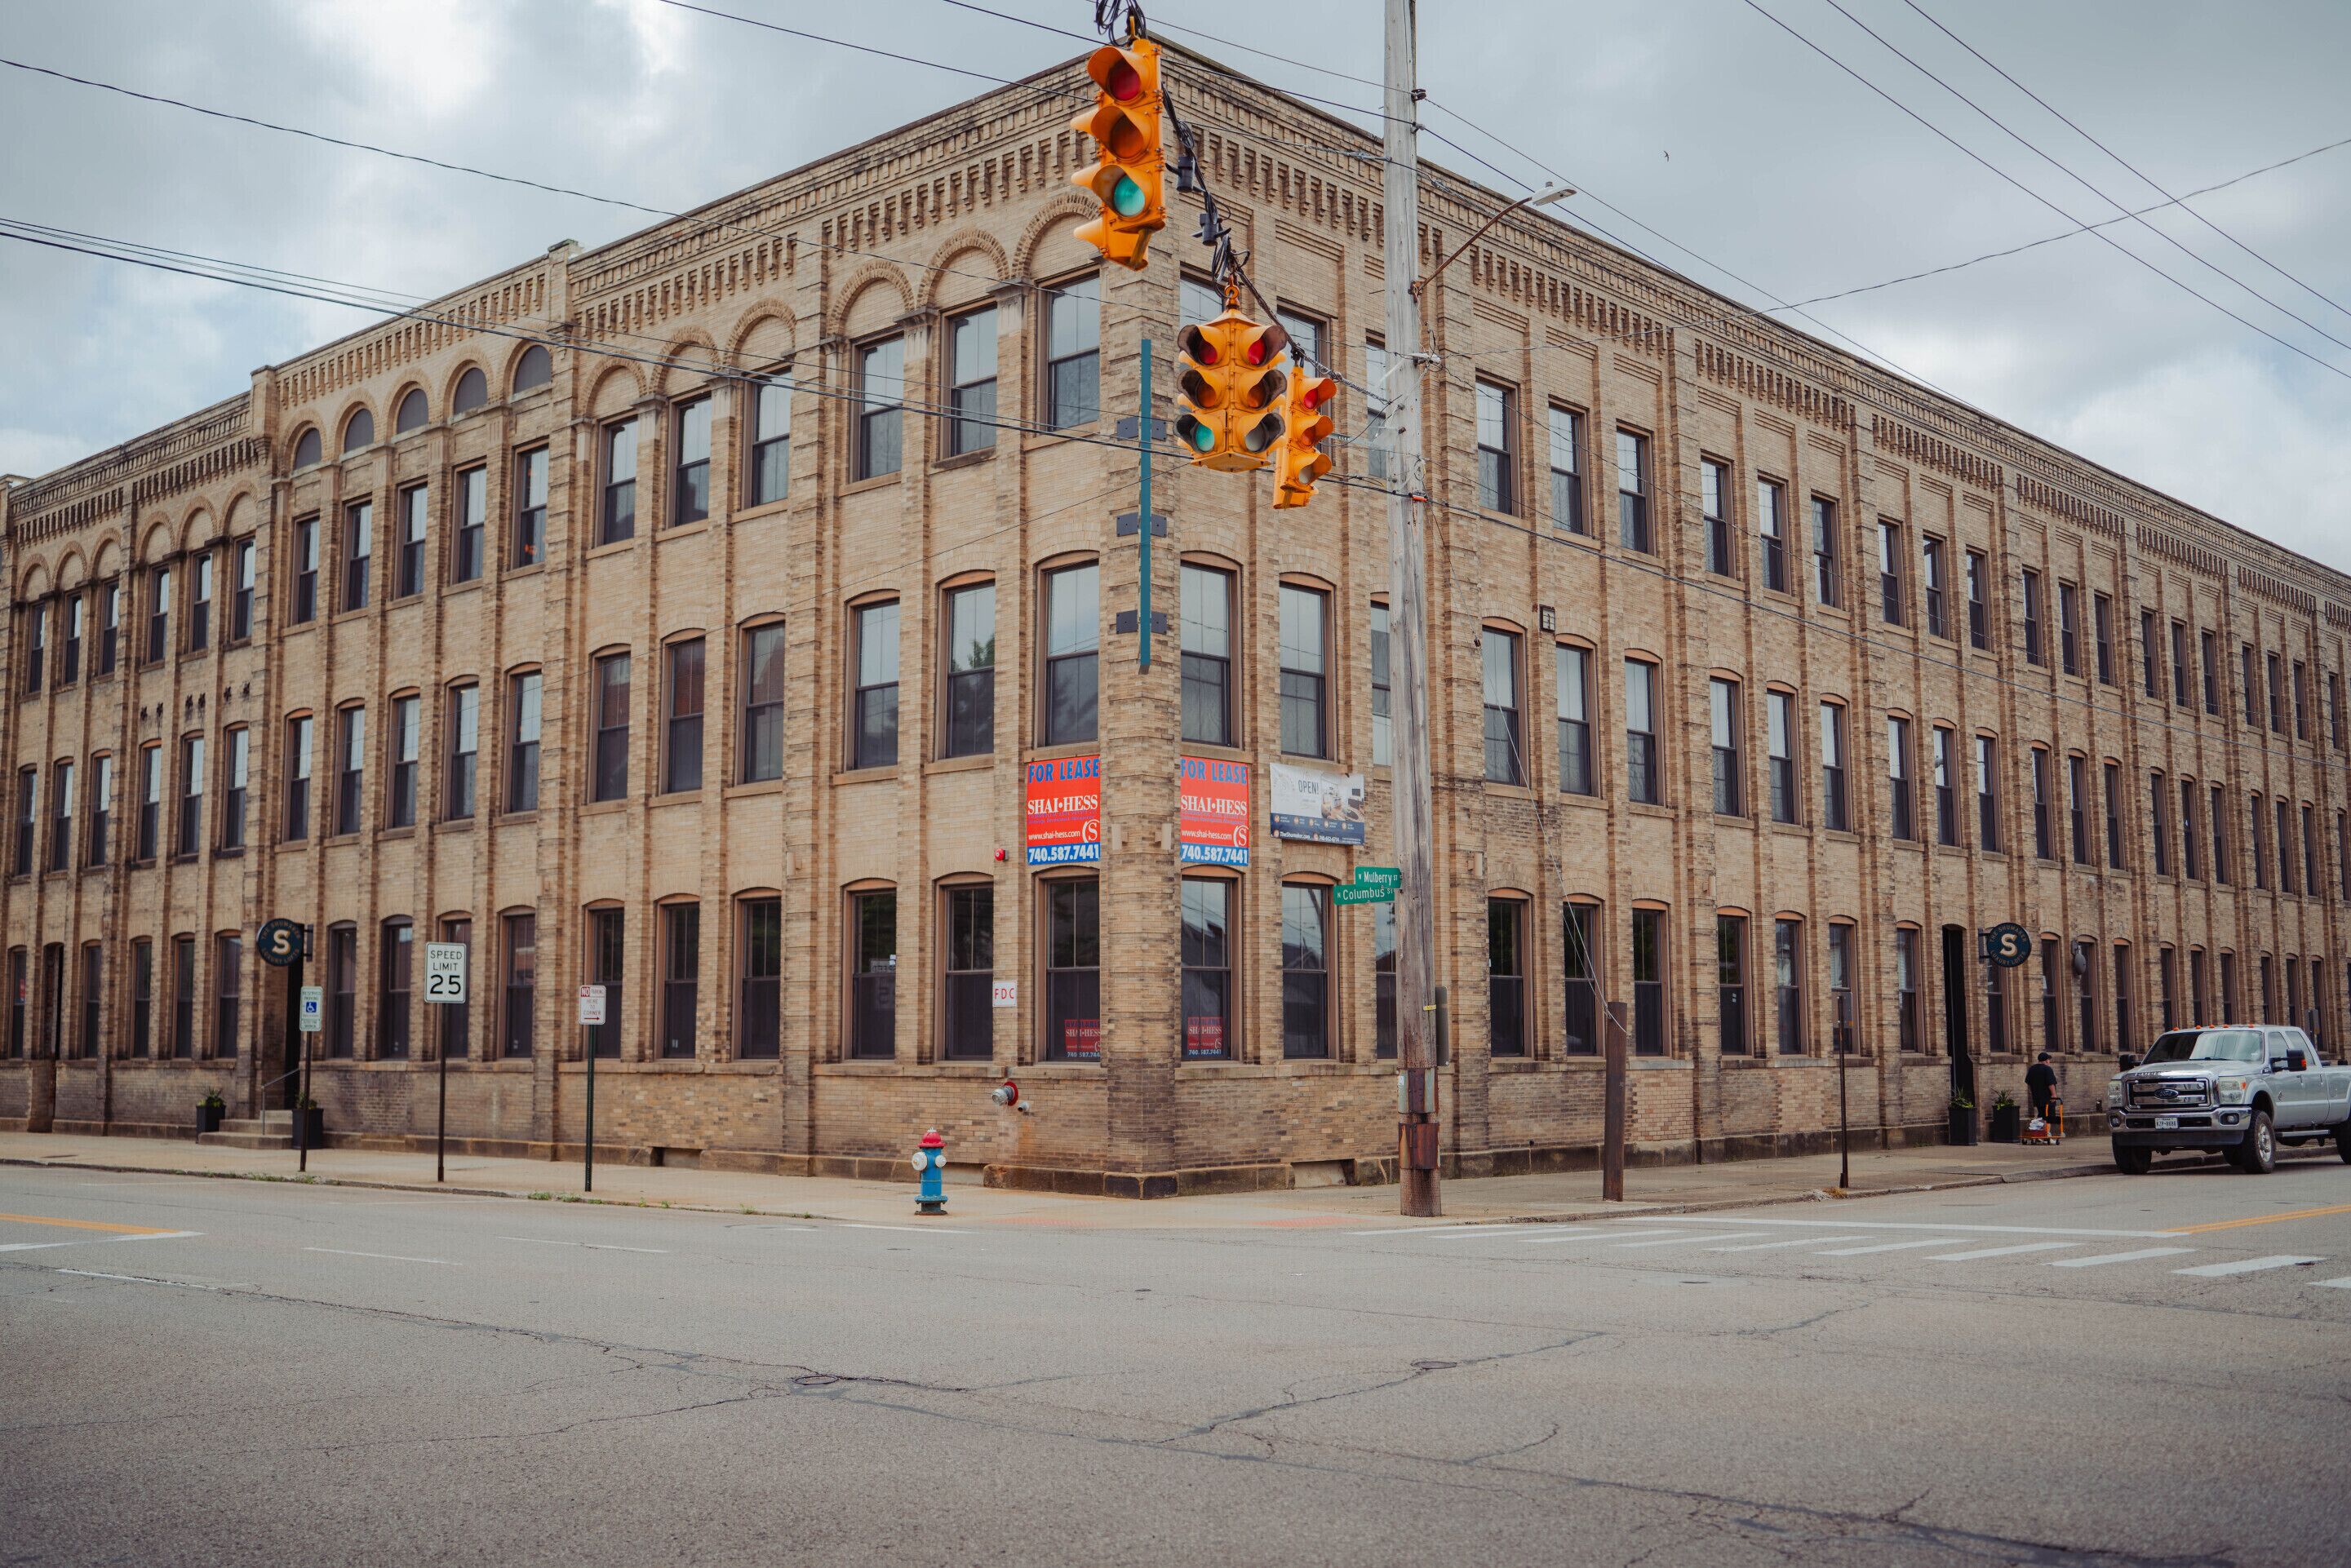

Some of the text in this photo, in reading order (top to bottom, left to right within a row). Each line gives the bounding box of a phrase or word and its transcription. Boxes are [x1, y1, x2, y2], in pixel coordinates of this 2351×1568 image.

[1029, 758, 1099, 783] FOR LEASE
[1180, 759, 1247, 784] FOR LEASE
[1297, 780, 1319, 795] OPEN!
[1028, 831, 1080, 840] www.shai-hess.com
[1181, 829, 1232, 840] www.shai-hess.com
[1029, 844, 1099, 862] 740.587.7441
[1182, 844, 1248, 864] 740.587.7441
[1364, 871, 1392, 886] Mulberry
[1342, 887, 1385, 901] Columbus
[272, 929, 291, 955] S
[2000, 933, 2018, 957] S
[430, 950, 463, 960] SPEED
[432, 963, 458, 972] LIMIT
[430, 974, 461, 995] 25
[582, 987, 590, 996] NO
[994, 987, 1014, 1000] FDC
